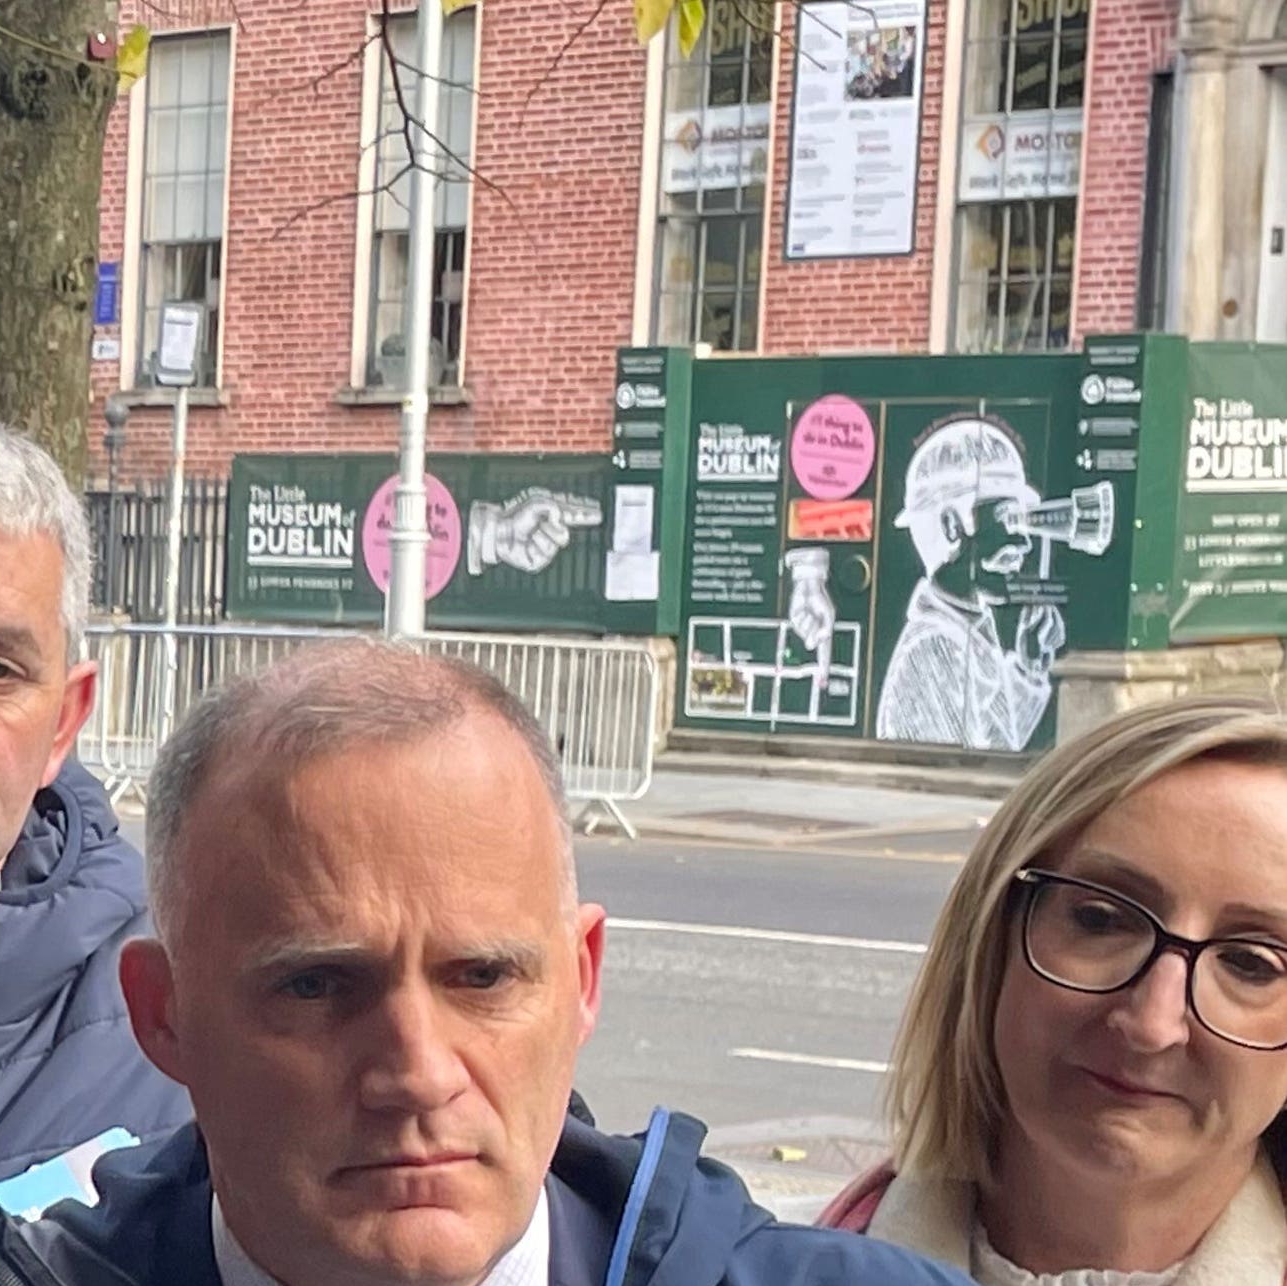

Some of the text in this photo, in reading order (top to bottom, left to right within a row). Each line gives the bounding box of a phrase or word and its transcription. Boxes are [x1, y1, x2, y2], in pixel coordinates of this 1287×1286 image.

[1193, 397, 1217, 420] The
[698, 453, 780, 474] DUBLIN
[1187, 446, 1287, 479] DUBLI
[250, 485, 271, 502] The
[248, 503, 342, 527] MUSEUM
[248, 527, 354, 556] DUBLIN
